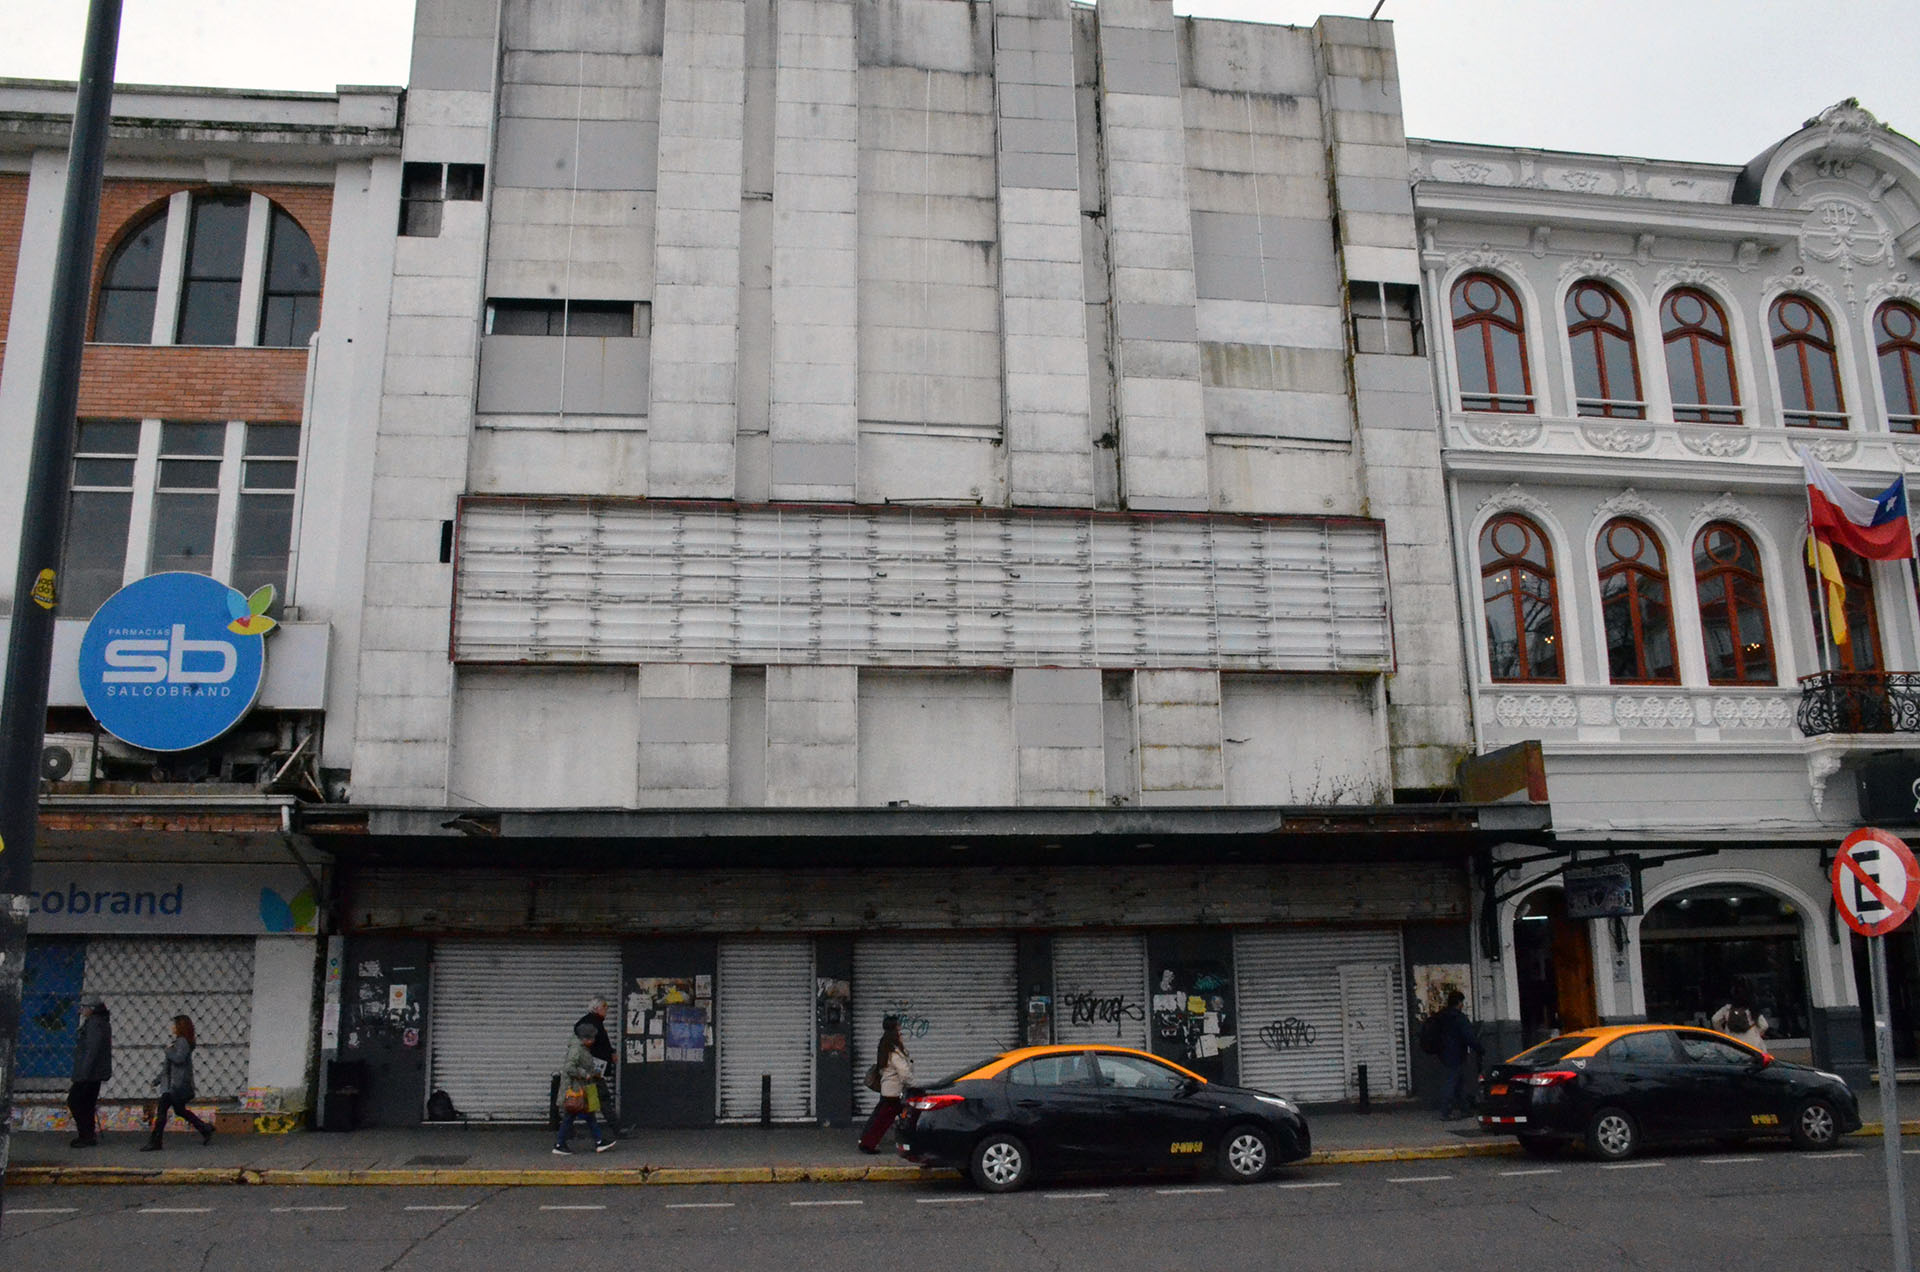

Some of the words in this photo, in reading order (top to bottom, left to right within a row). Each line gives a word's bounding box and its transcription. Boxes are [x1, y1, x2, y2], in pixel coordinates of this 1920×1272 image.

[108, 628, 171, 636] FARMACIAS
[102, 624, 237, 683] sb
[106, 686, 231, 697] SALCOBRAND
[1852, 850, 1885, 912] E
